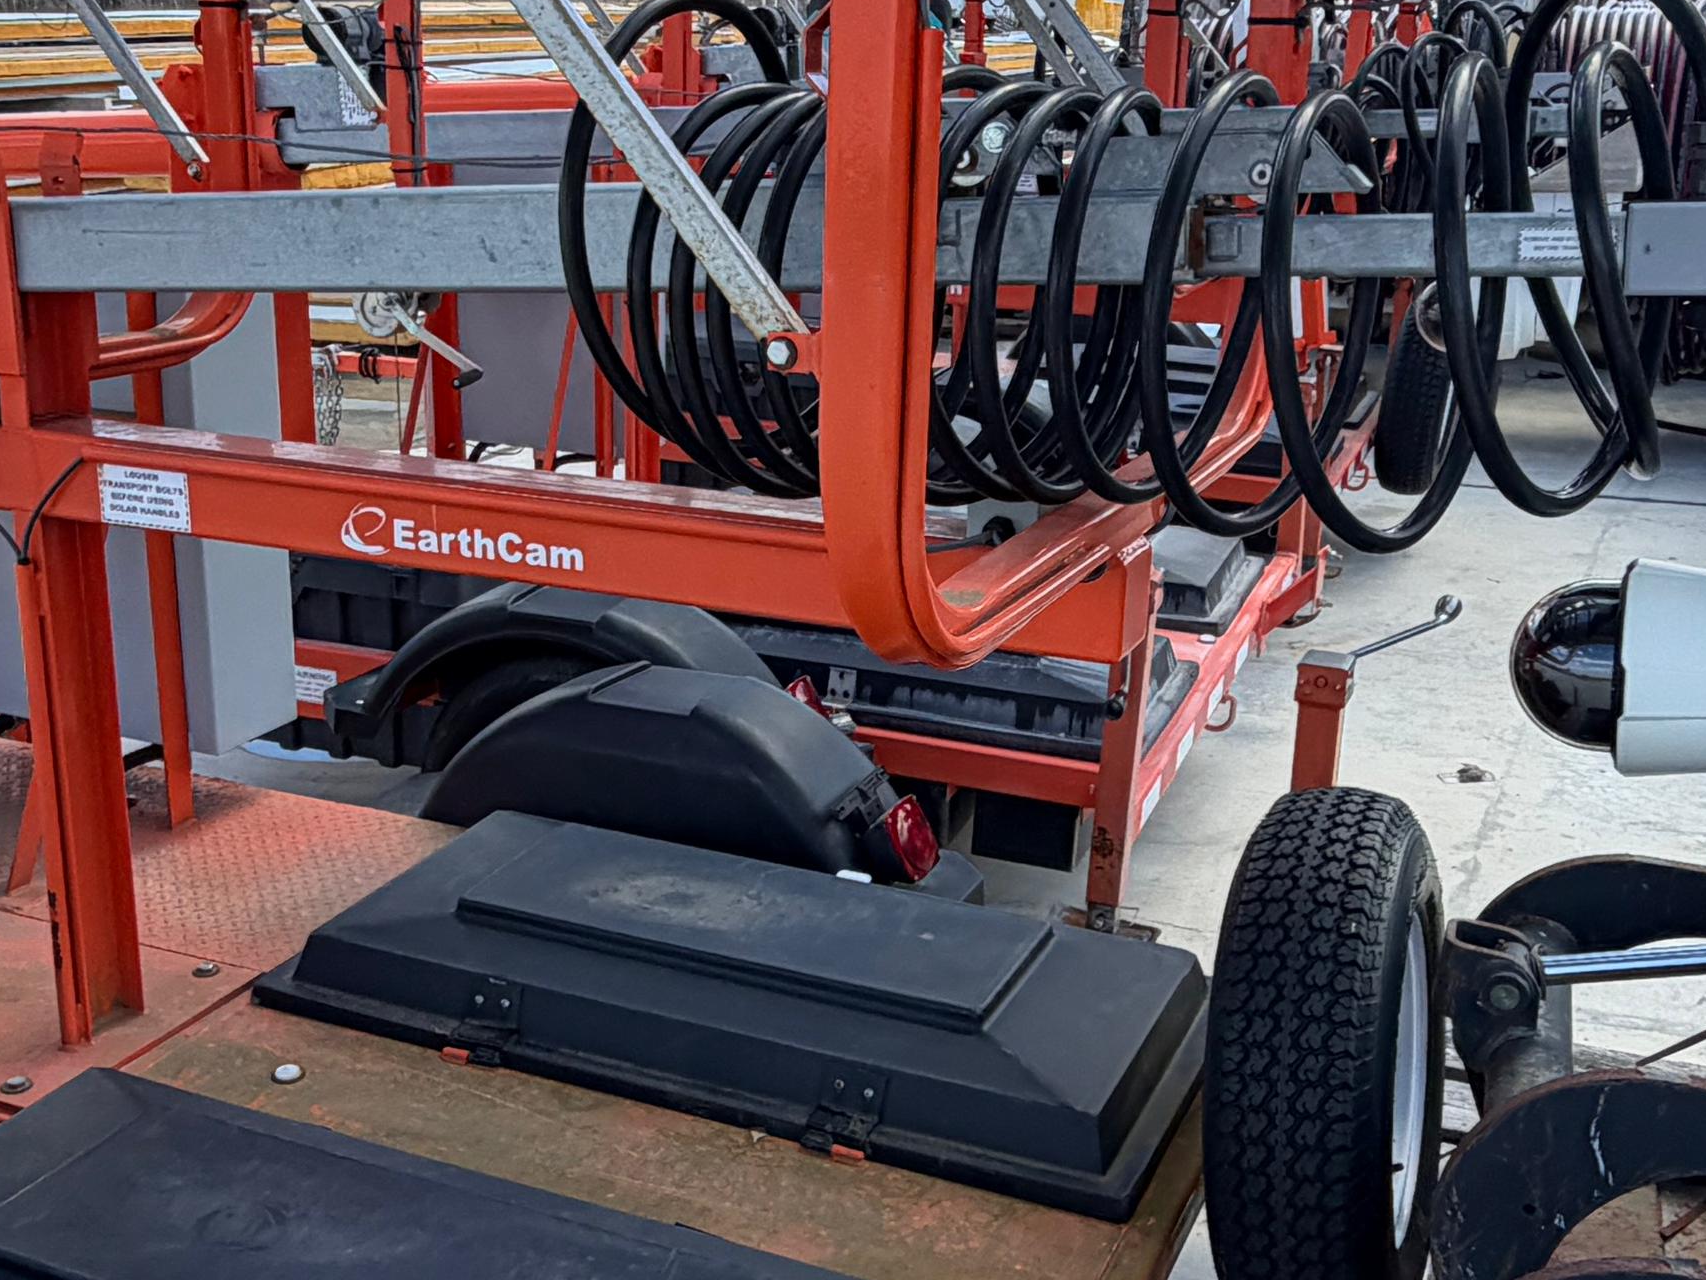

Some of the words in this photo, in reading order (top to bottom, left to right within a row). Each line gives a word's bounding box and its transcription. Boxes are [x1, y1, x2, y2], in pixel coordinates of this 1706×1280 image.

[124, 471, 159, 481] LOOSEN
[103, 480, 153, 492] TRANSPORT
[156, 486, 184, 496] BOLTS
[111, 492, 144, 503] BEFORE
[109, 503, 138, 514] SOLAR
[139, 507, 180, 519] HANDLES
[393, 518, 584, 572] EarthCam
